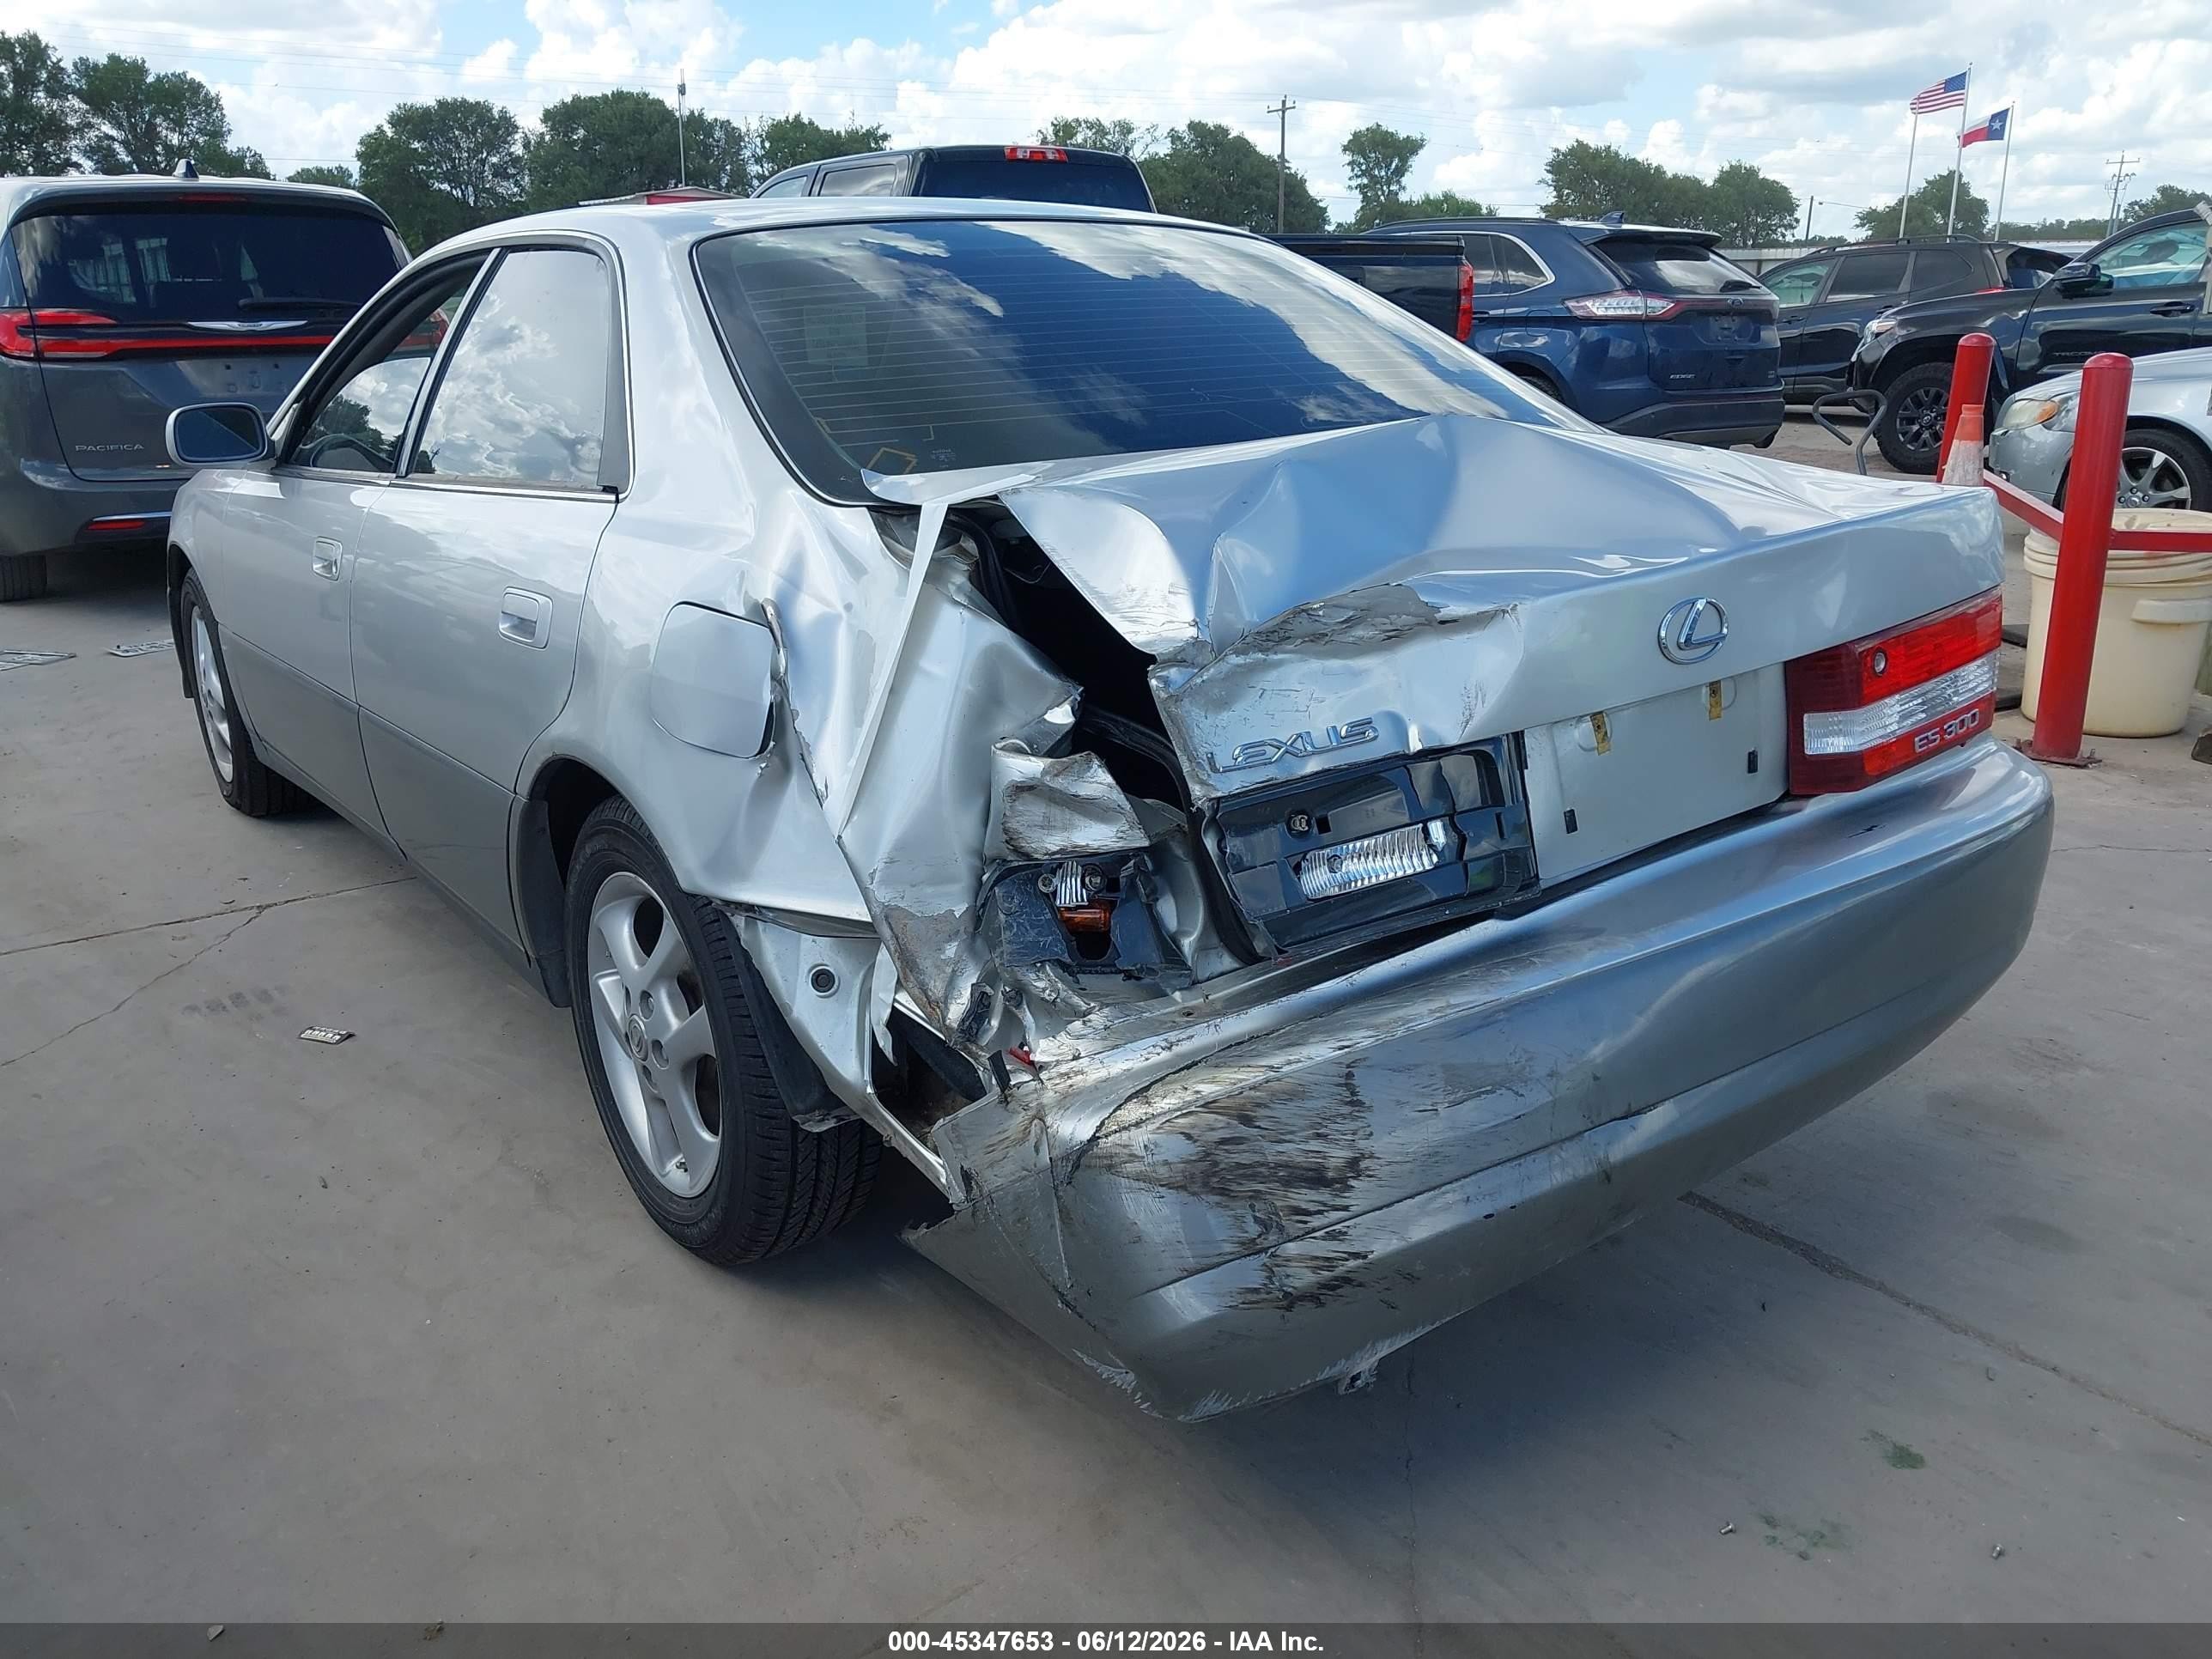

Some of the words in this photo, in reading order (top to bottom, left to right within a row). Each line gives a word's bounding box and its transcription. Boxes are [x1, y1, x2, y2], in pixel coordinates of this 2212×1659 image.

[1206, 717, 1379, 773] LEXUS
[1914, 727, 1941, 754] ES
[1943, 708, 1979, 740] 300
